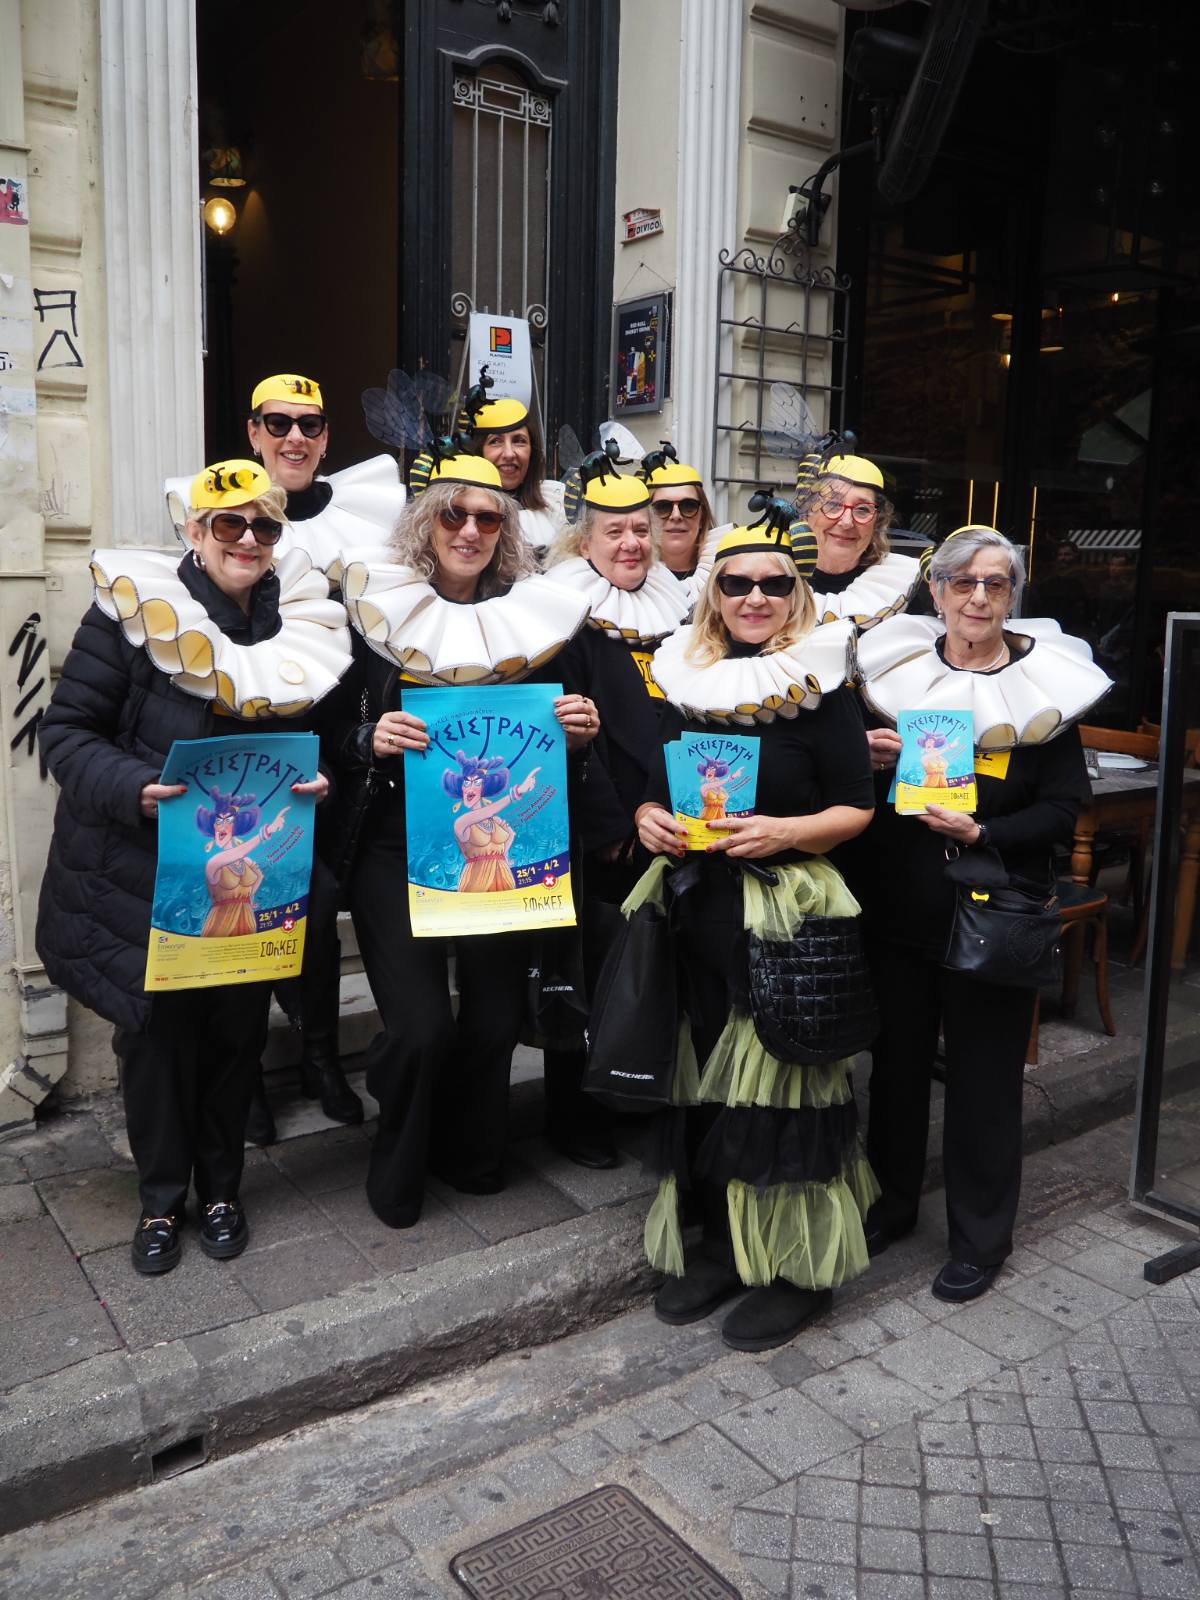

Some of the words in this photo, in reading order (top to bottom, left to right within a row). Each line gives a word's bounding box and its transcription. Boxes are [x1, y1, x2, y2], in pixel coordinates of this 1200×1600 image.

[636, 220, 660, 235] DIVICO
[516, 865, 536, 879] 25/1
[544, 859, 560, 873] 4/2
[258, 910, 278, 922] 25/1
[285, 902, 300, 914] 4/2
